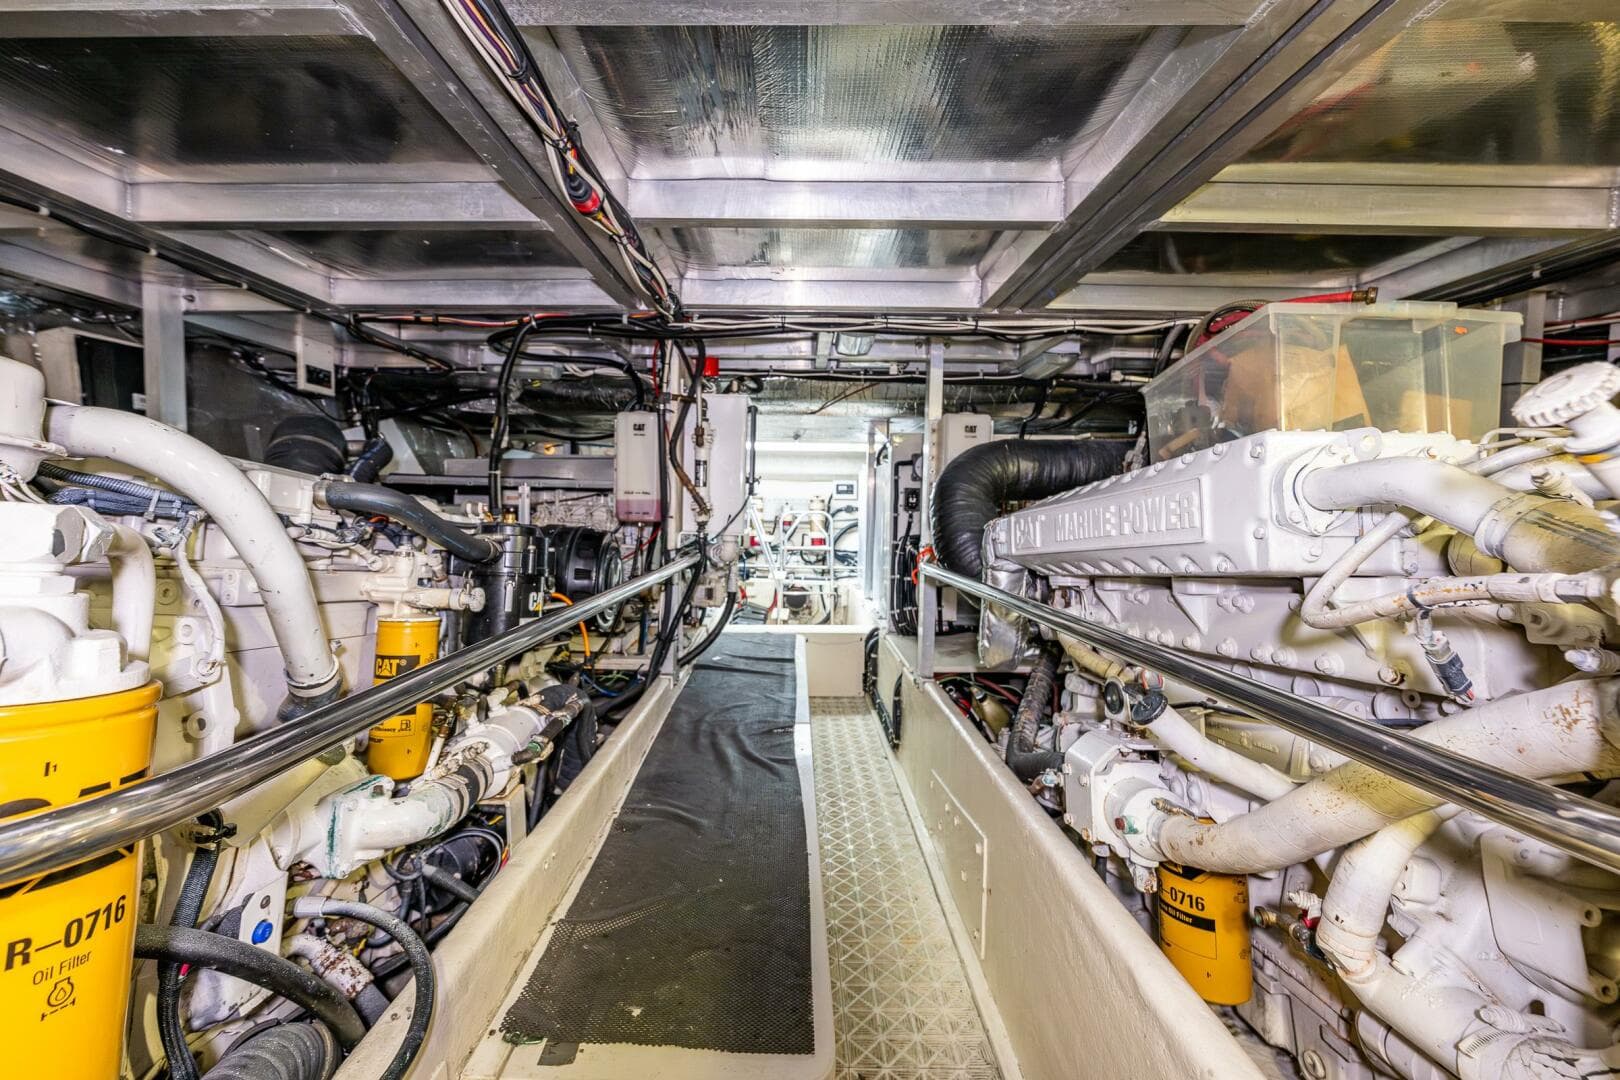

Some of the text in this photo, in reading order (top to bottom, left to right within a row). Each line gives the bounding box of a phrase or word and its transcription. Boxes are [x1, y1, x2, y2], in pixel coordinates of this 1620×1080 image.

[1015, 491, 1200, 550] CAT MARINE POWER
[375, 658, 400, 677] CAT
[33, 950, 92, 986] Oil Filter
